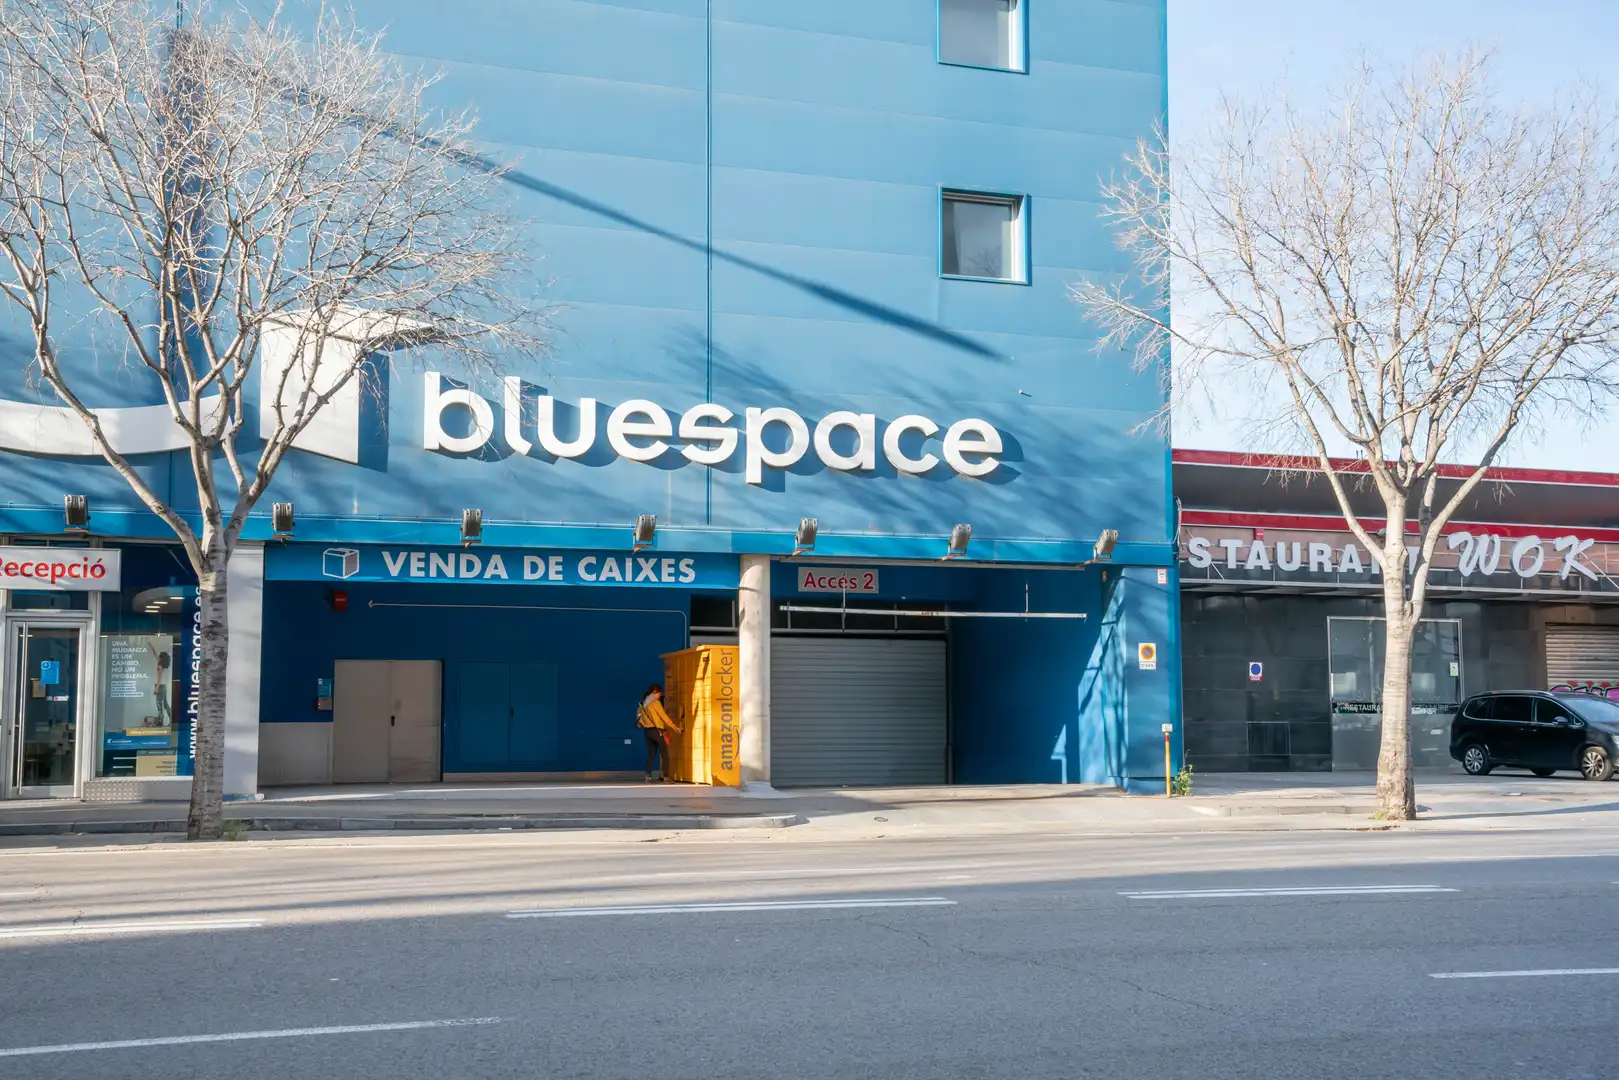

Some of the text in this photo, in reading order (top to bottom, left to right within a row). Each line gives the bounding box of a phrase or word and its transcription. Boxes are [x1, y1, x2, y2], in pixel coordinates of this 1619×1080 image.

[424, 371, 1003, 483] bluespace
[0, 556, 106, 584] ecepció
[381, 551, 696, 583] VENDA DE CAIXES
[1188, 531, 1598, 581] STAURAT WOK
[803, 571, 874, 590] Accés 2
[716, 648, 733, 771] amazonlocker
